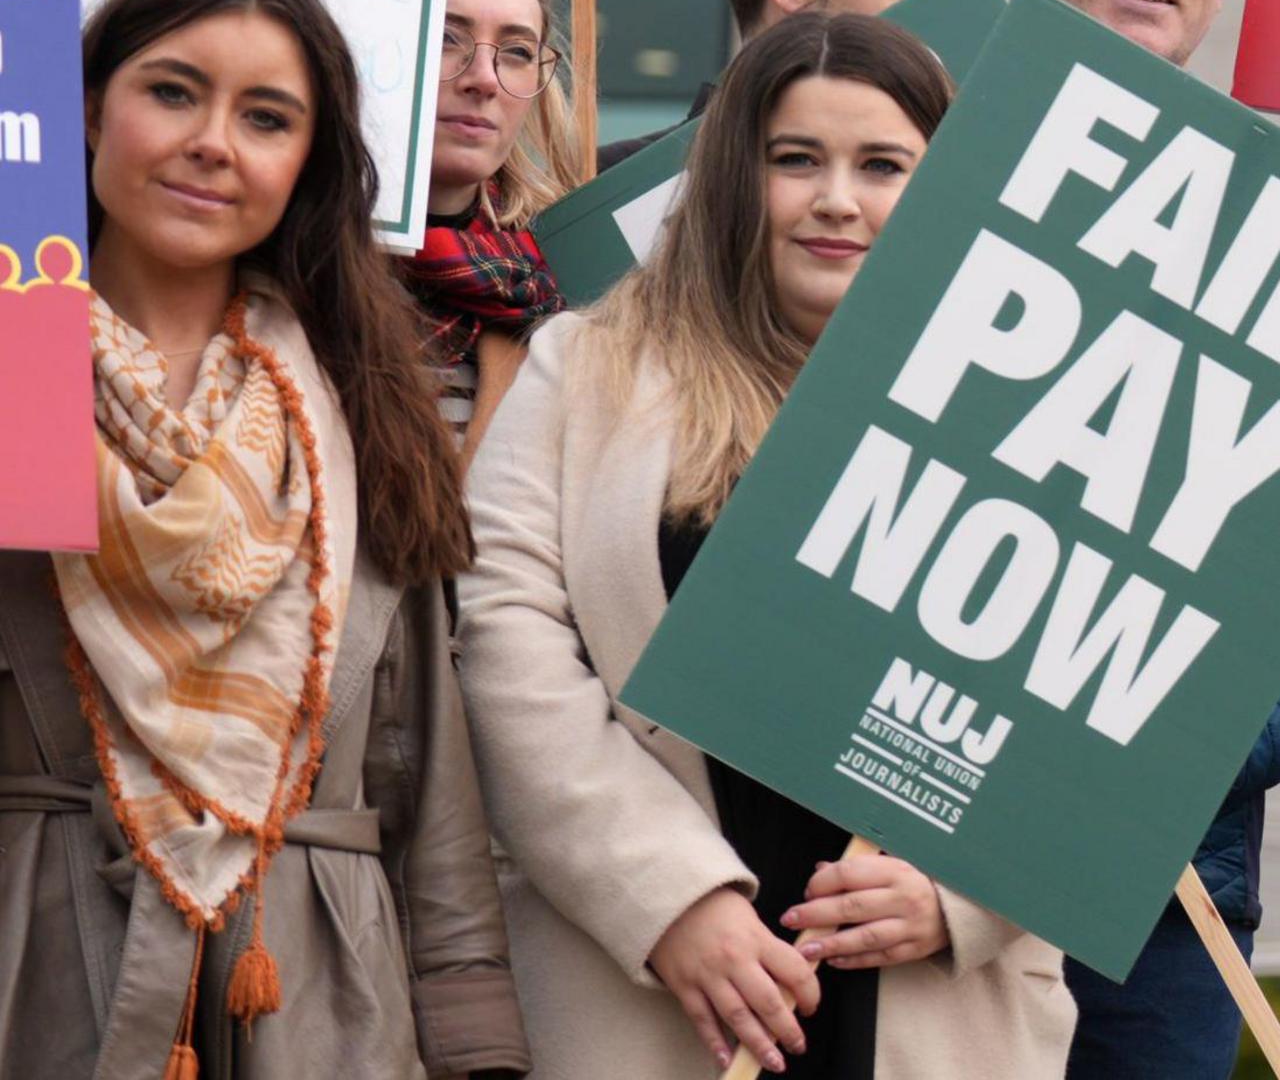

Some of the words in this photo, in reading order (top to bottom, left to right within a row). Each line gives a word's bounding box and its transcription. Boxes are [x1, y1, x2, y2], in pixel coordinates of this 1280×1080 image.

[796, 425, 1221, 747] NOW
[871, 655, 1014, 765] NUJ
[839, 747, 964, 824] JOURNALISTS
[858, 714, 931, 764] NATIONAL
[934, 756, 983, 792] UNION
[902, 761, 921, 777] OF
